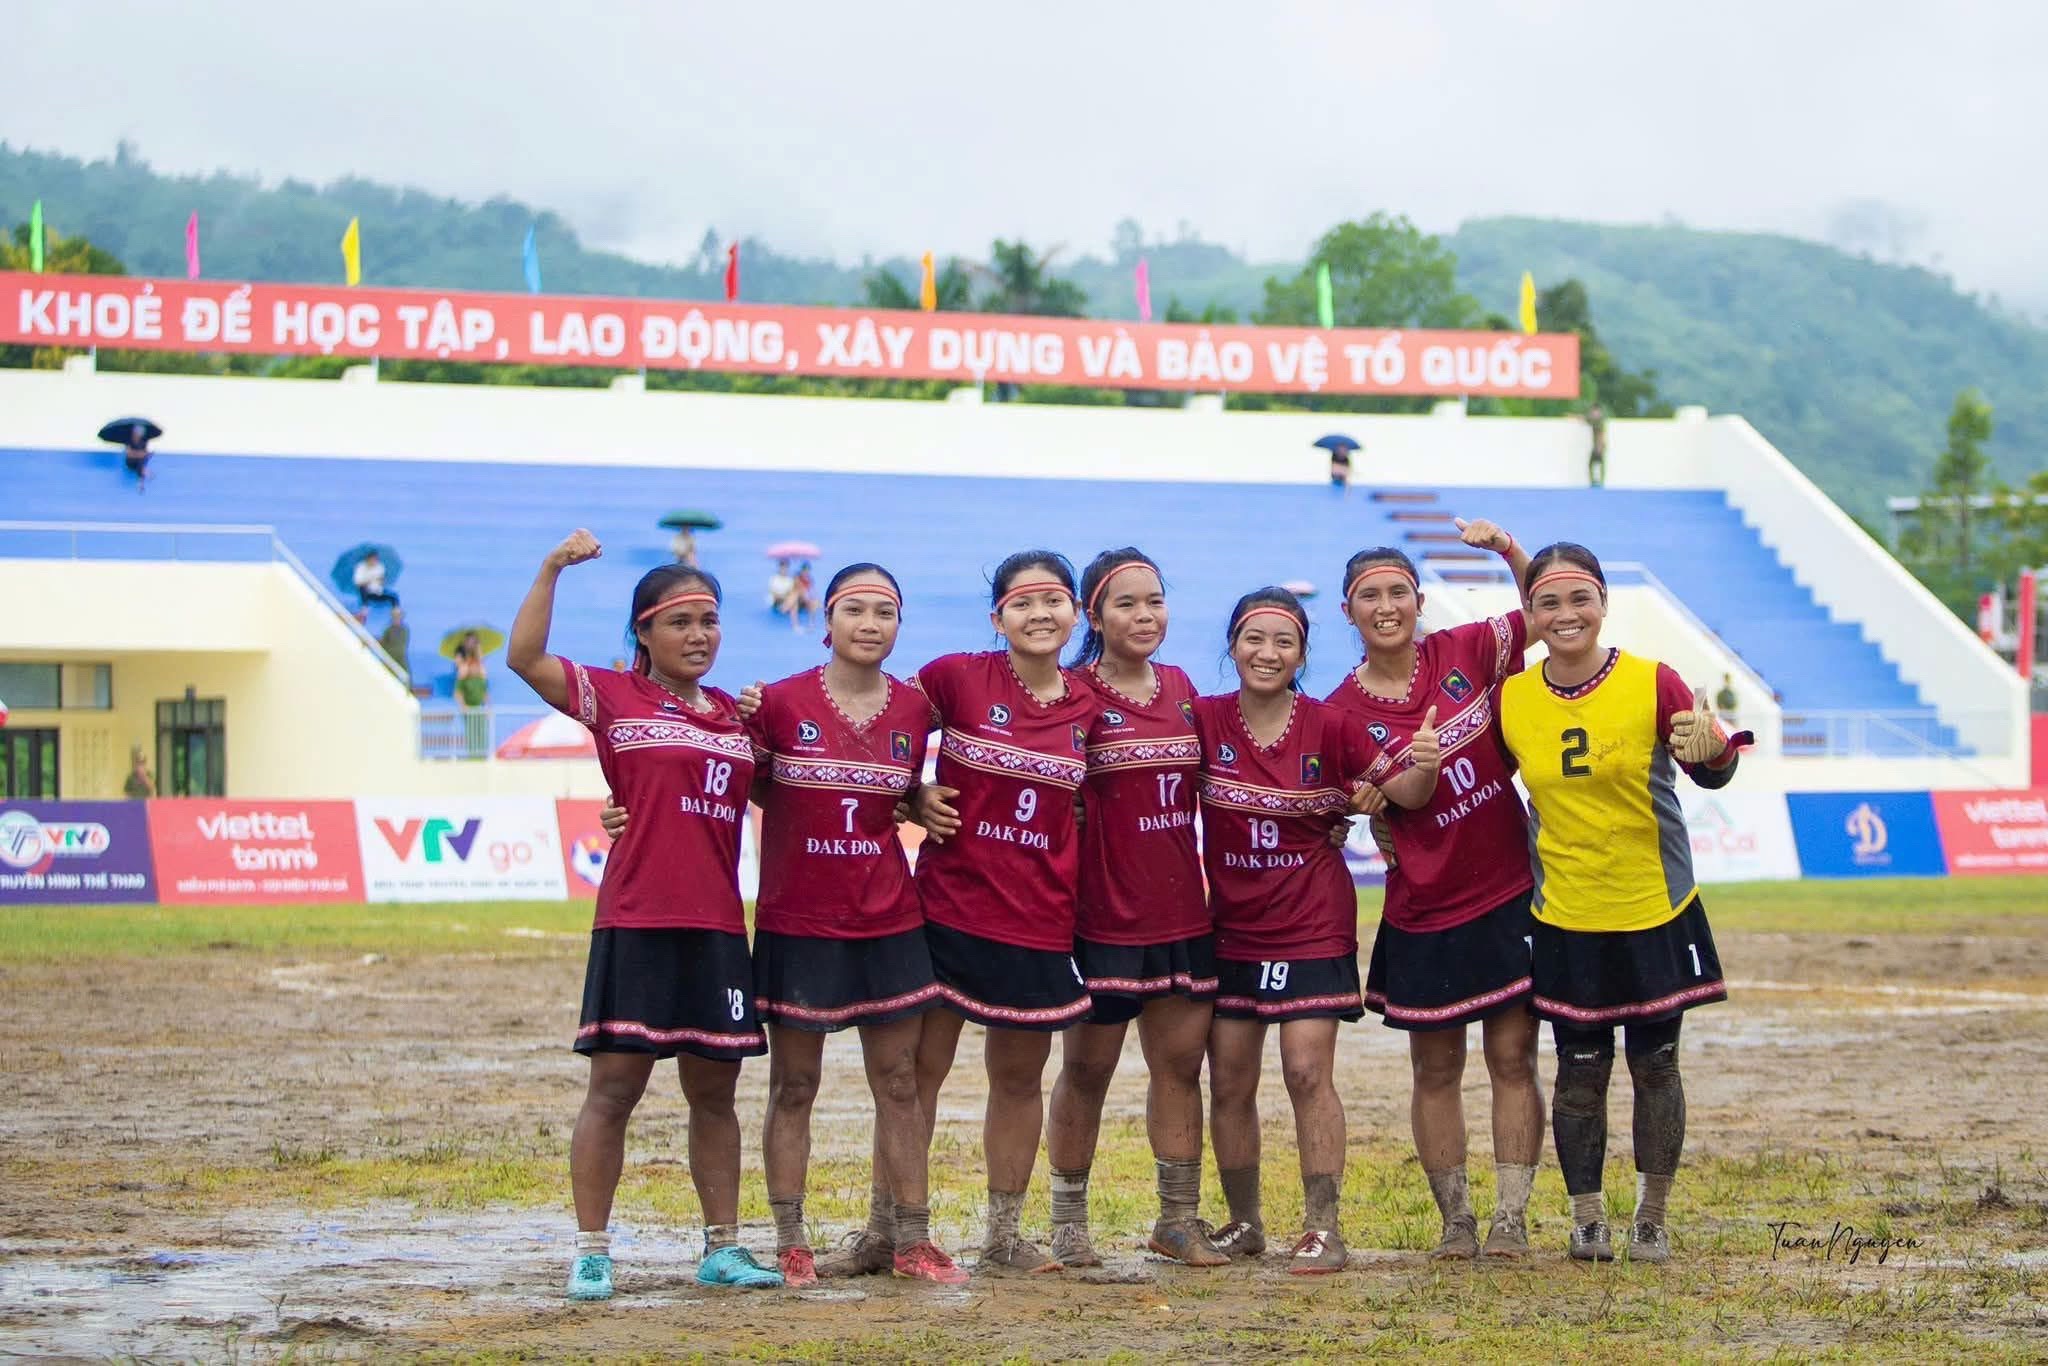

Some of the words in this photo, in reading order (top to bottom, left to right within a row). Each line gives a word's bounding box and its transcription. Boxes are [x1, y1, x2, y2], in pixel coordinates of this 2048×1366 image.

[19, 283, 163, 340] KHOẺ
[273, 300, 381, 354] HỌC
[397, 298, 508, 359] TẬP,
[529, 310, 625, 357] LAO
[641, 308, 797, 370] ĐỘNG,
[816, 317, 913, 369] XÂY
[928, 327, 1065, 379] DỰNG
[1077, 327, 1143, 379] VÀ
[1157, 330, 1253, 382] BẢO
[1268, 335, 1328, 390] VỆ
[1421, 335, 1552, 388] QUỐC
[1561, 727, 1592, 778] 2
[704, 758, 732, 796] 18
[1156, 773, 1182, 807] 17
[1442, 757, 1476, 796] 10
[841, 798, 859, 832] 7
[1015, 788, 1037, 822] 9
[373, 818, 482, 863] VTV
[806, 838, 847, 855] ĐAK
[850, 840, 882, 855] ĐOA
[1247, 817, 1279, 849] 19
[1260, 961, 1289, 991] 19
[1688, 943, 1701, 976] 1
